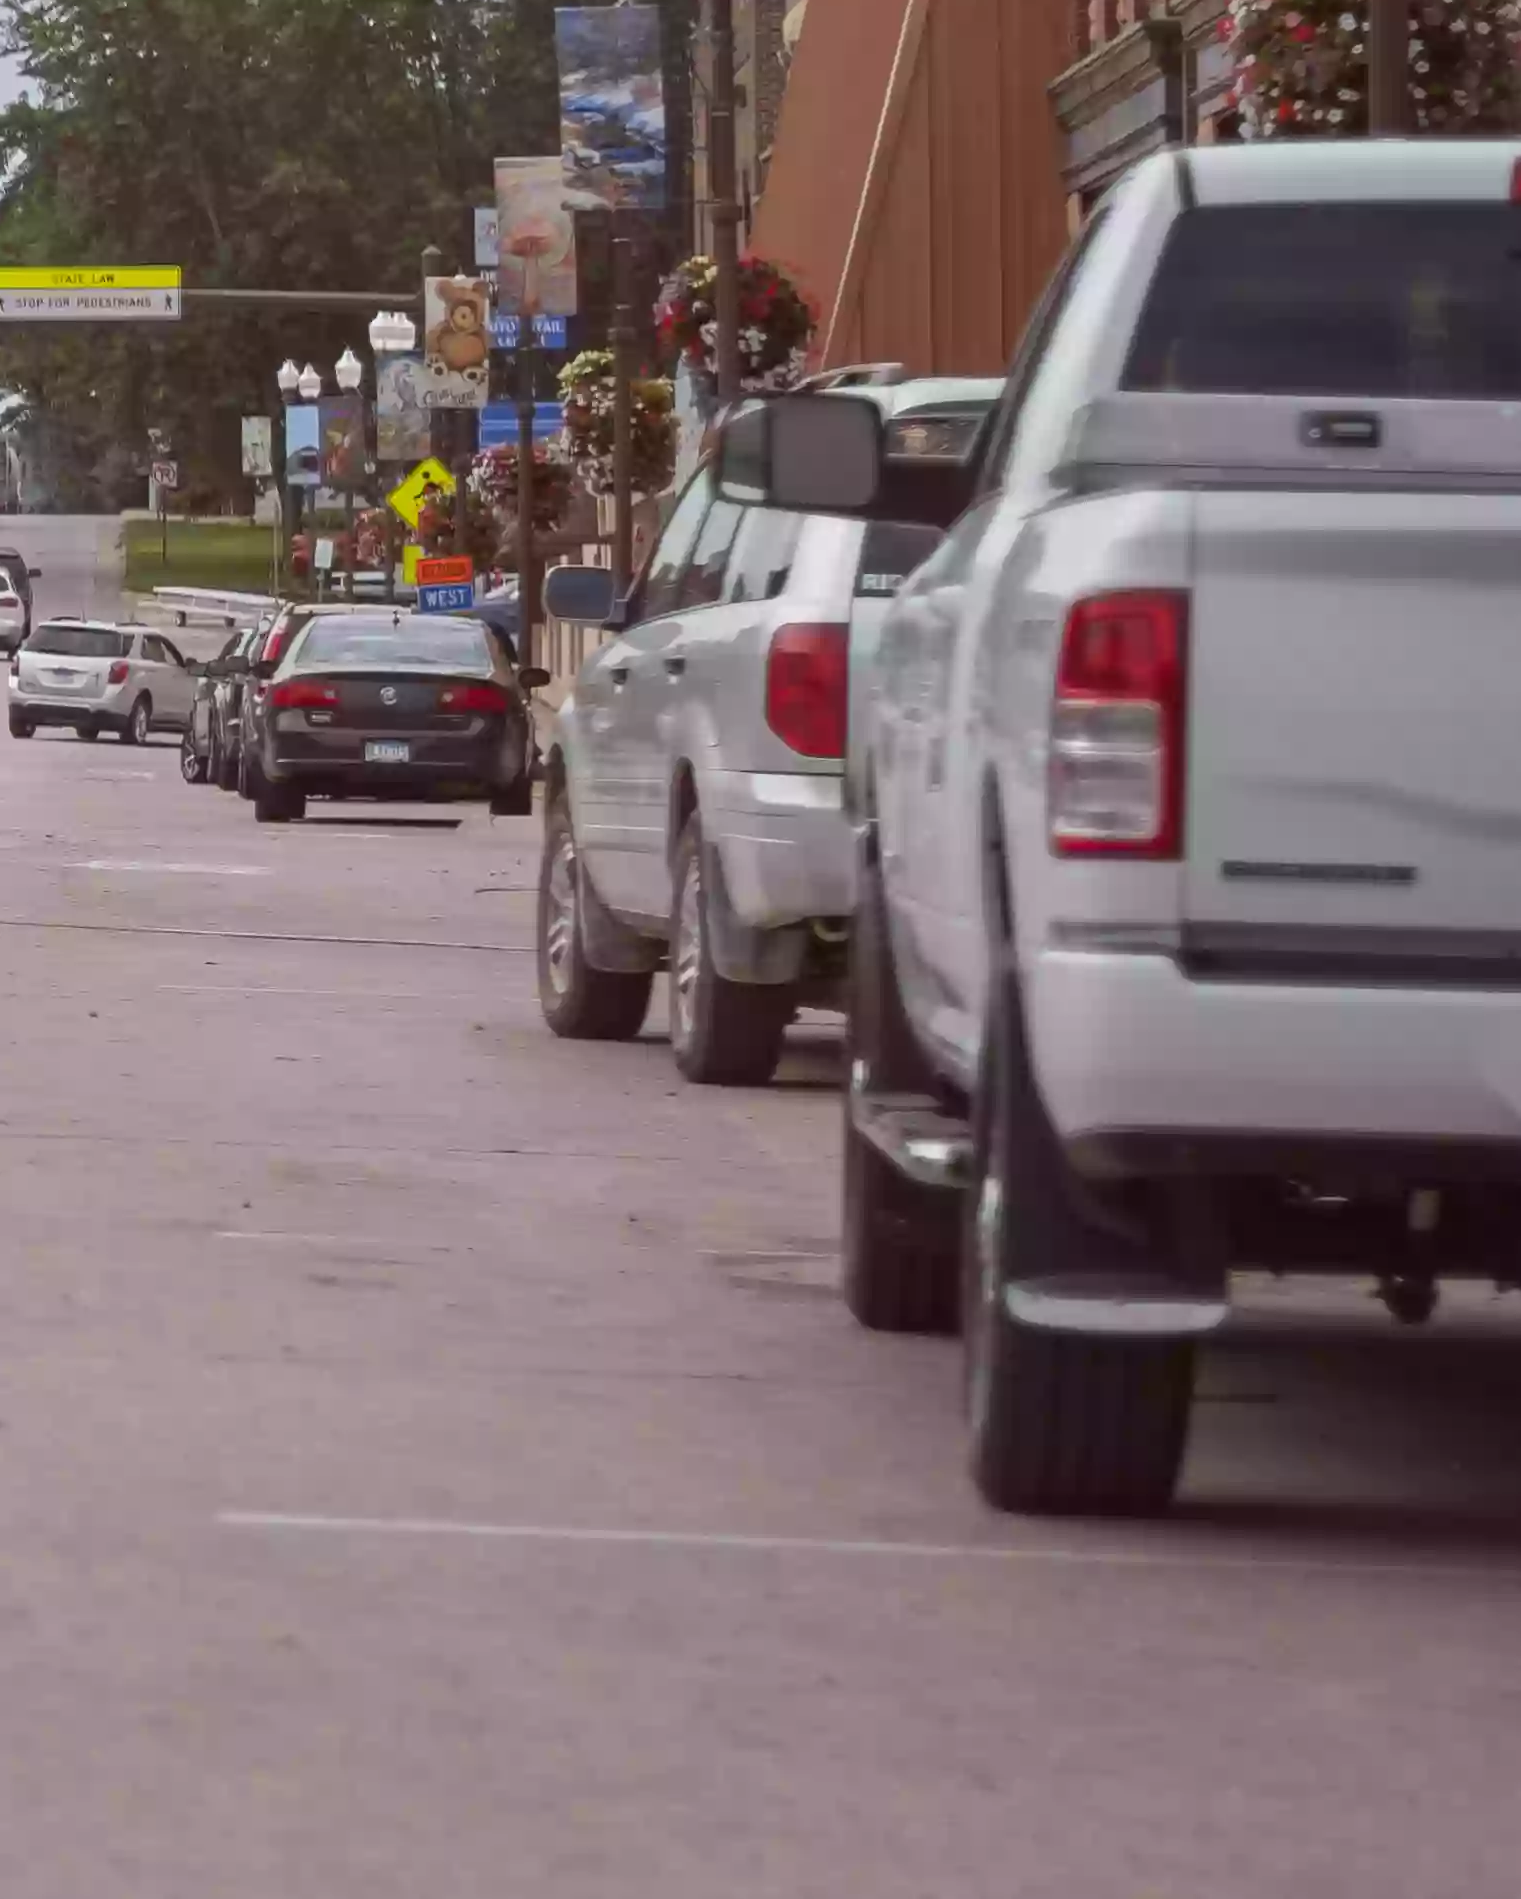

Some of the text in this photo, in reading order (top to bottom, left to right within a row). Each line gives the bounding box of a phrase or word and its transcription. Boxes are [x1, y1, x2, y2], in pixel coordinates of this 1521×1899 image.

[52, 274, 115, 284] STATE LAW
[15, 296, 152, 309] STOP FOR PEDESTRIANS
[425, 588, 465, 607] WEST
